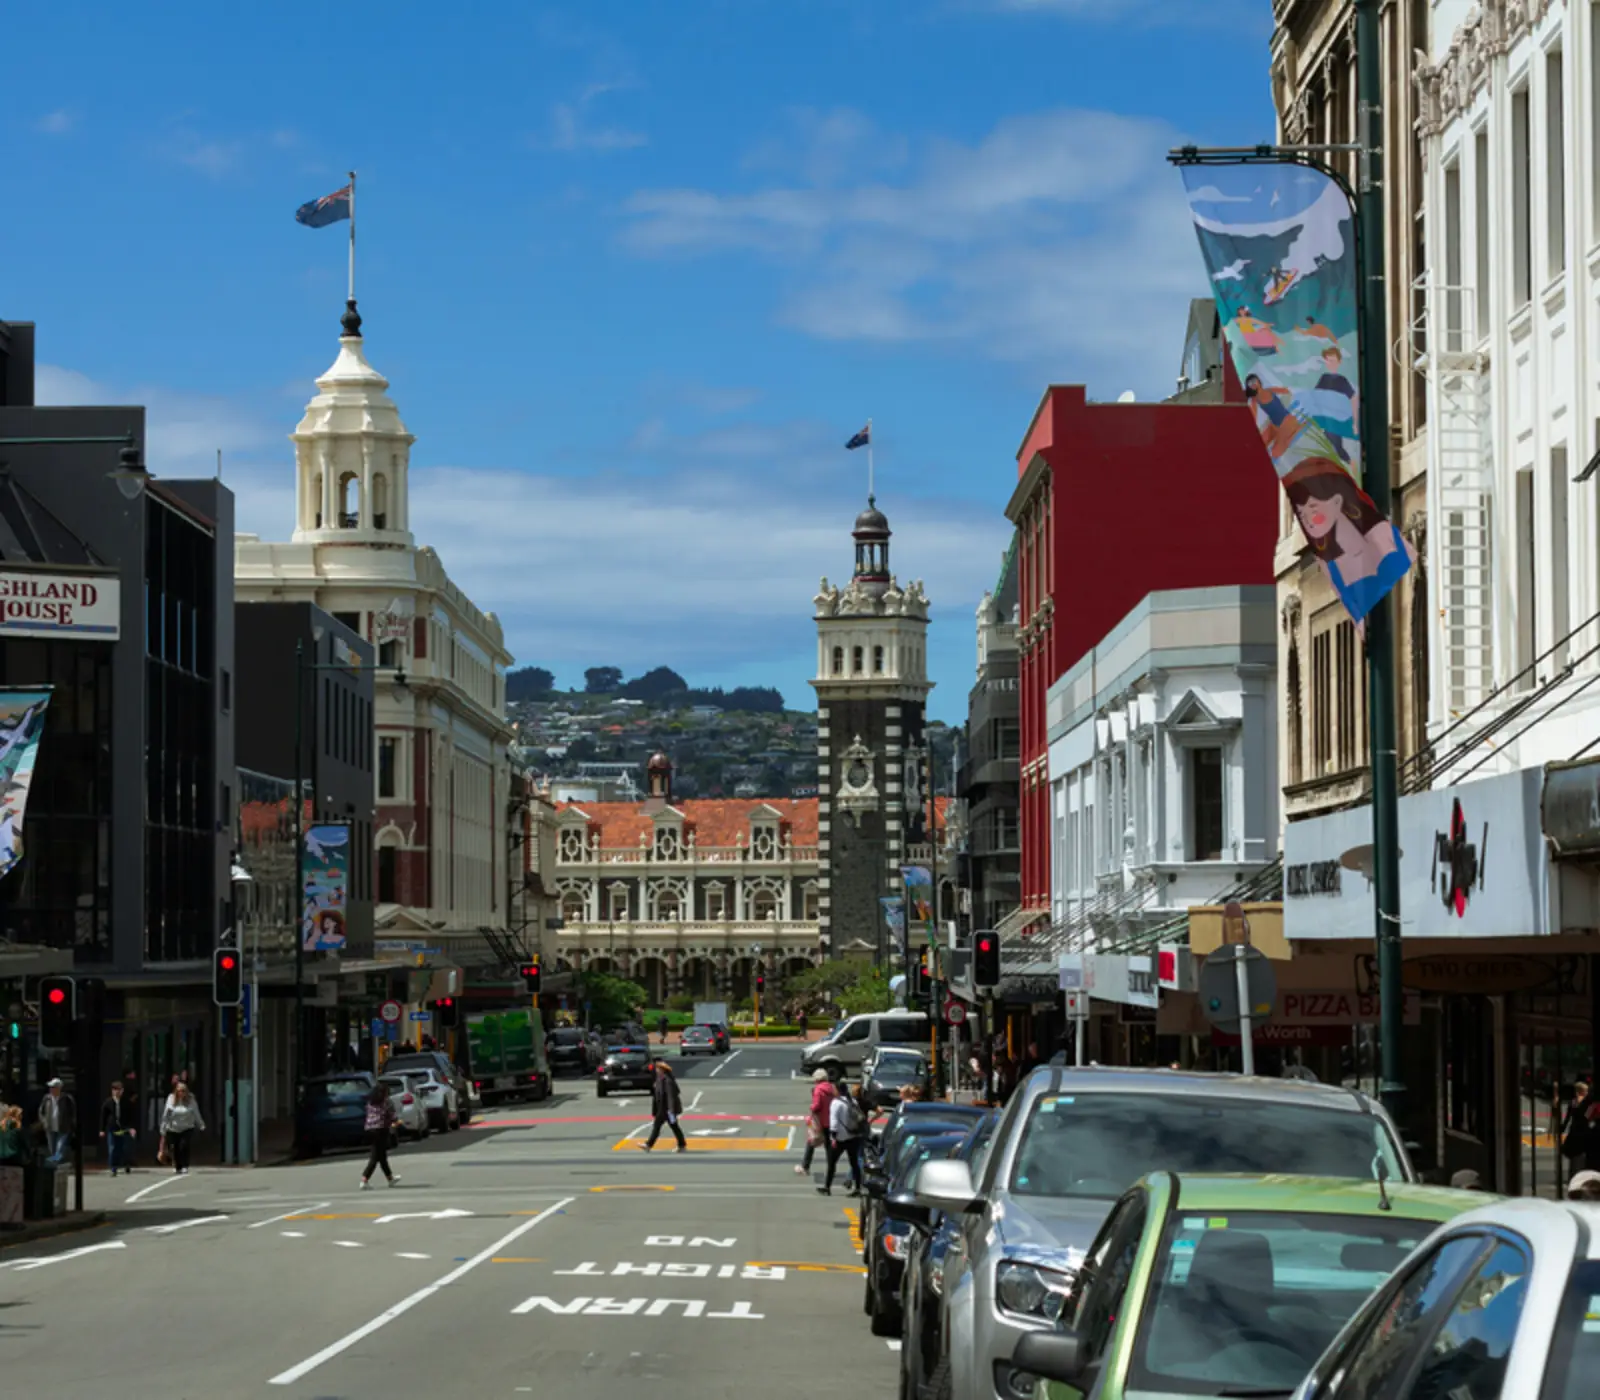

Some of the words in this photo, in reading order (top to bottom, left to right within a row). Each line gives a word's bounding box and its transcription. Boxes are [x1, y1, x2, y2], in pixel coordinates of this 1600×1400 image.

[1421, 959, 1459, 979] TWO
[1464, 962, 1525, 979] CHEFS
[1285, 995, 1351, 1017] PIZZA
[644, 1235, 738, 1247] NO
[553, 1261, 787, 1280] RIGHT
[510, 1295, 766, 1319] TURN
